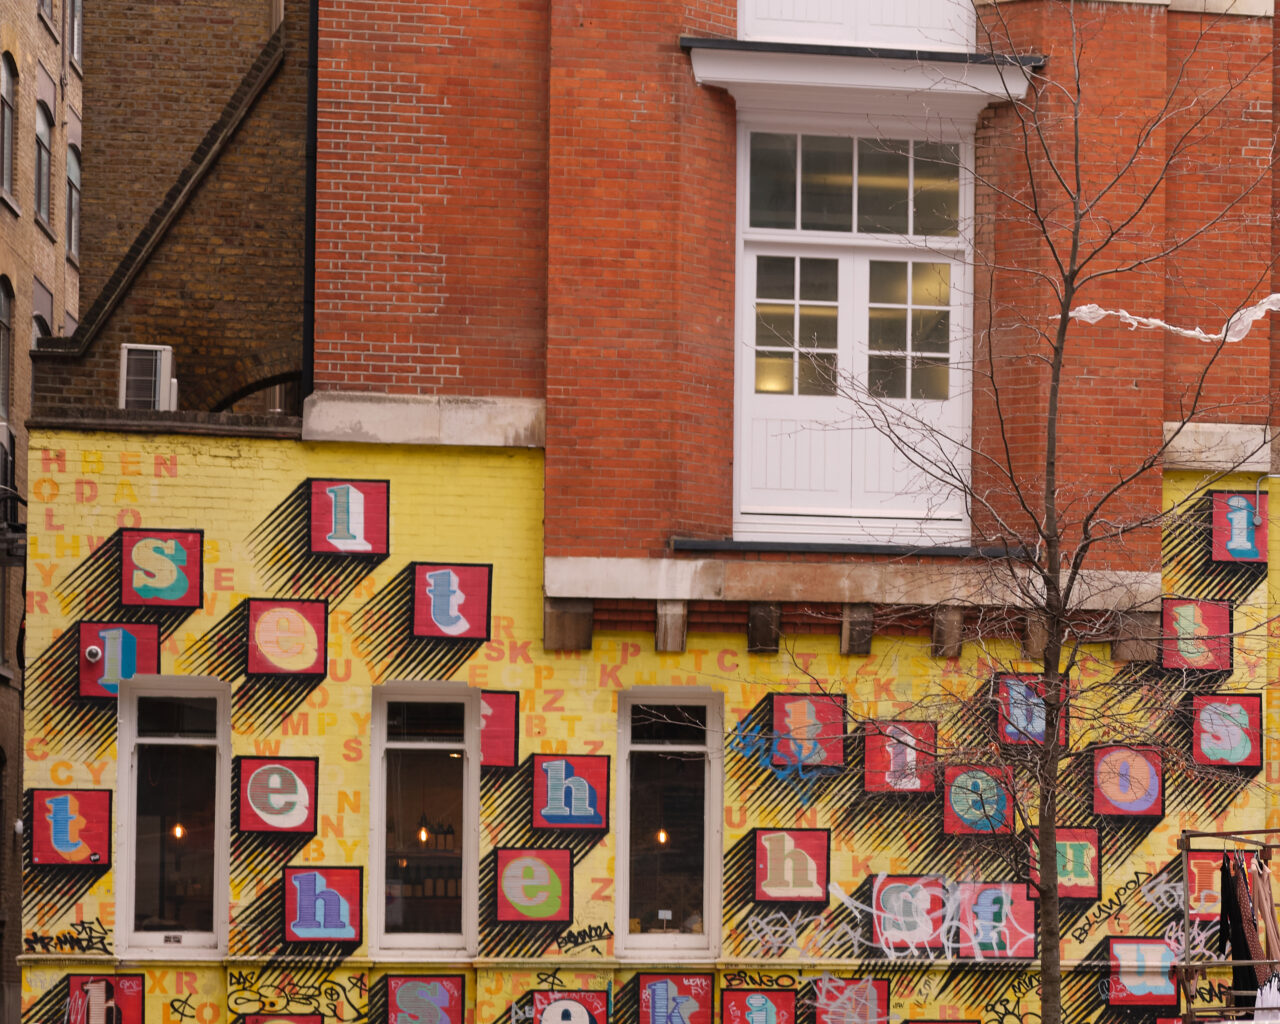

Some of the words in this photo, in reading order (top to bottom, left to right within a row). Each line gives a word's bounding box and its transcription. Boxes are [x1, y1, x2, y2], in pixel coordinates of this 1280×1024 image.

[1226, 495, 1260, 559] i
[247, 764, 310, 828] e
[540, 759, 603, 825] h
[45, 794, 91, 862] t
[501, 856, 562, 918] e
[761, 832, 823, 898] h
[291, 871, 356, 938] h
